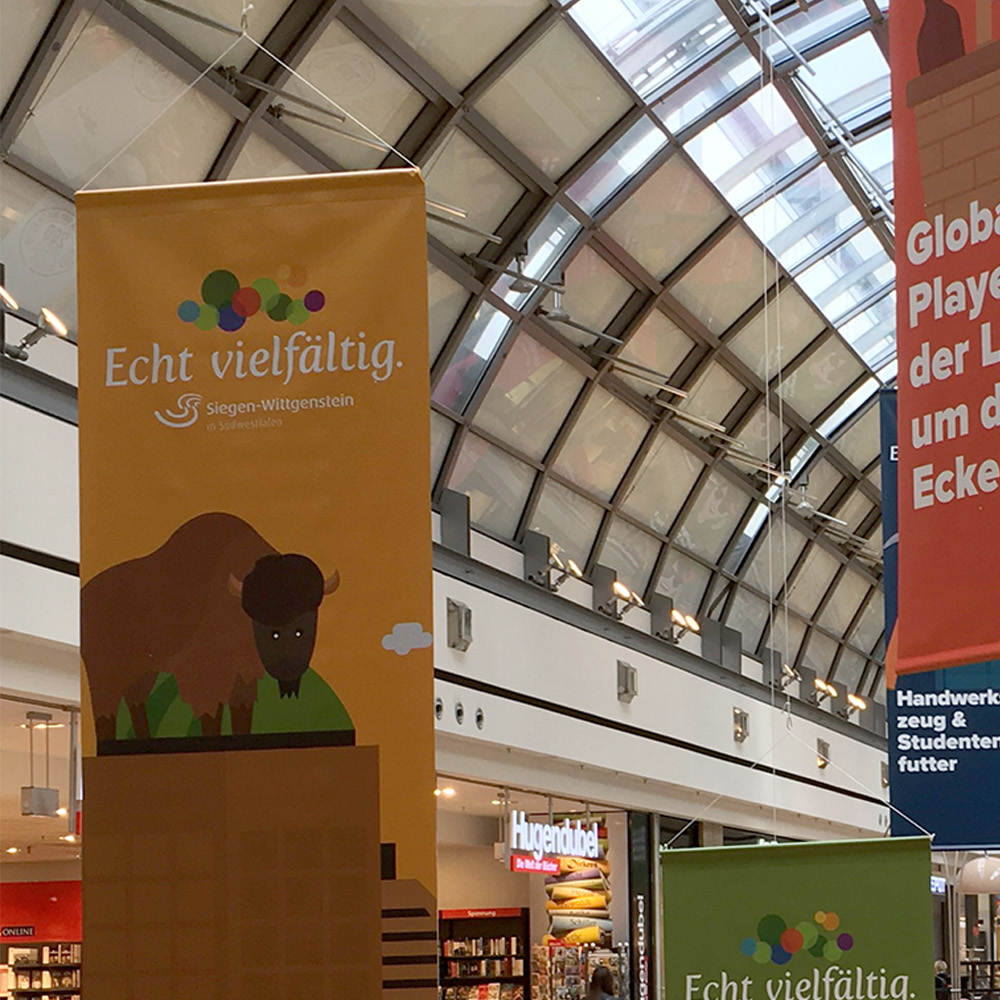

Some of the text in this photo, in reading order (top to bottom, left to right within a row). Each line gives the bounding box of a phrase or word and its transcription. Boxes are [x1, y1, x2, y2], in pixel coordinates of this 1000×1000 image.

[105, 330, 403, 387] Echt vielfältig.
[909, 340, 969, 388] der
[206, 393, 354, 416] Siegen-Wittgenstein
[911, 404, 969, 449] um
[912, 455, 1000, 510] Ecke
[896, 711, 968, 732] zeug &
[897, 756, 958, 773] futter
[511, 810, 599, 860] Hugendubel
